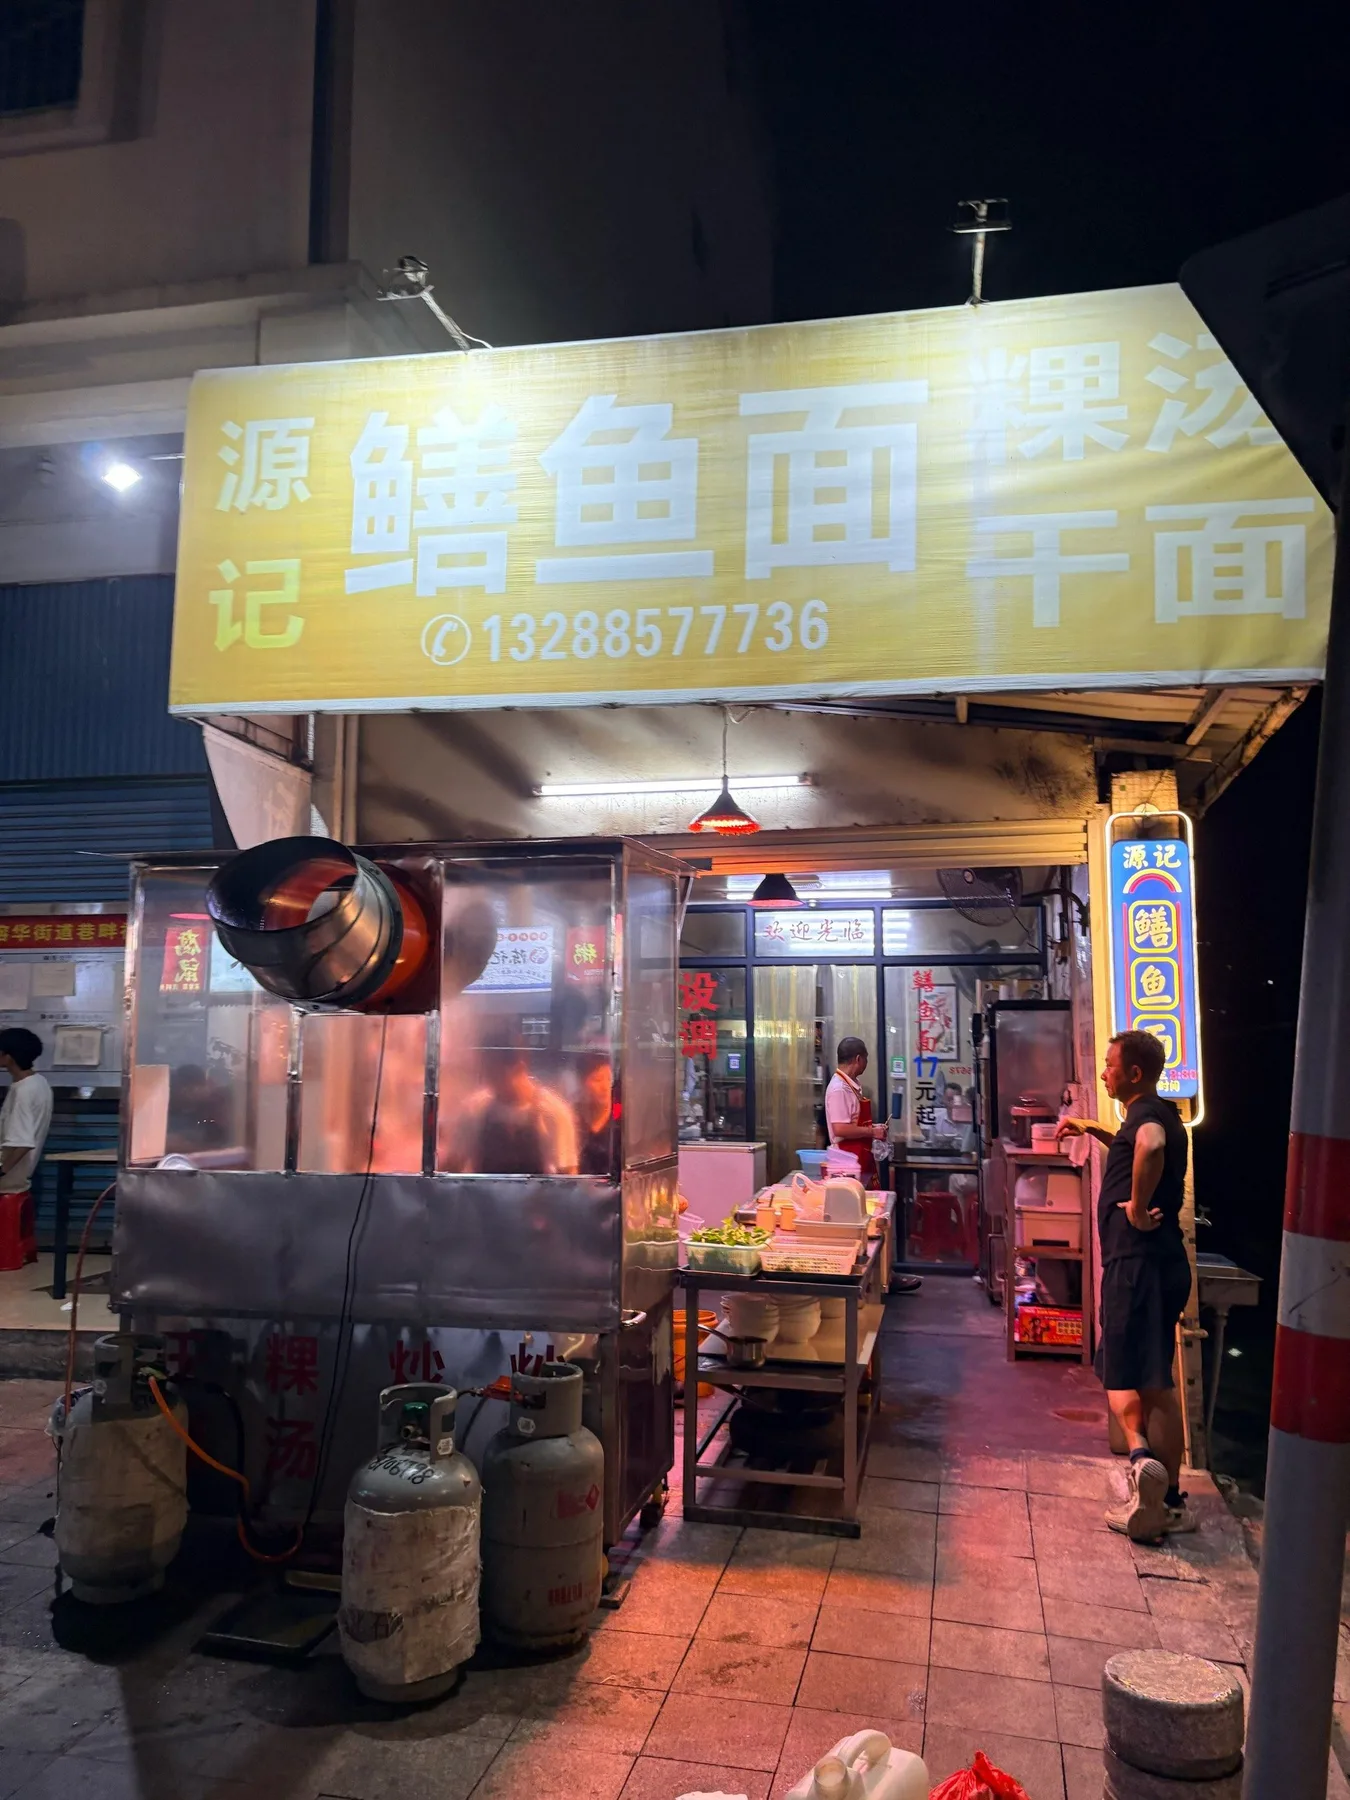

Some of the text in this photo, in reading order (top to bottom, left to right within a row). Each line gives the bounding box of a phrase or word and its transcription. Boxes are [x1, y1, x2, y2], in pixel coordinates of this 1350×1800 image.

[208, 416, 315, 651] 源记
[345, 379, 928, 597] 鳝鱼面
[966, 496, 1314, 628] 干面
[483, 598, 829, 663] 13288577736
[1122, 844, 1182, 869] 源记
[764, 918, 865, 942] 欢迎光临
